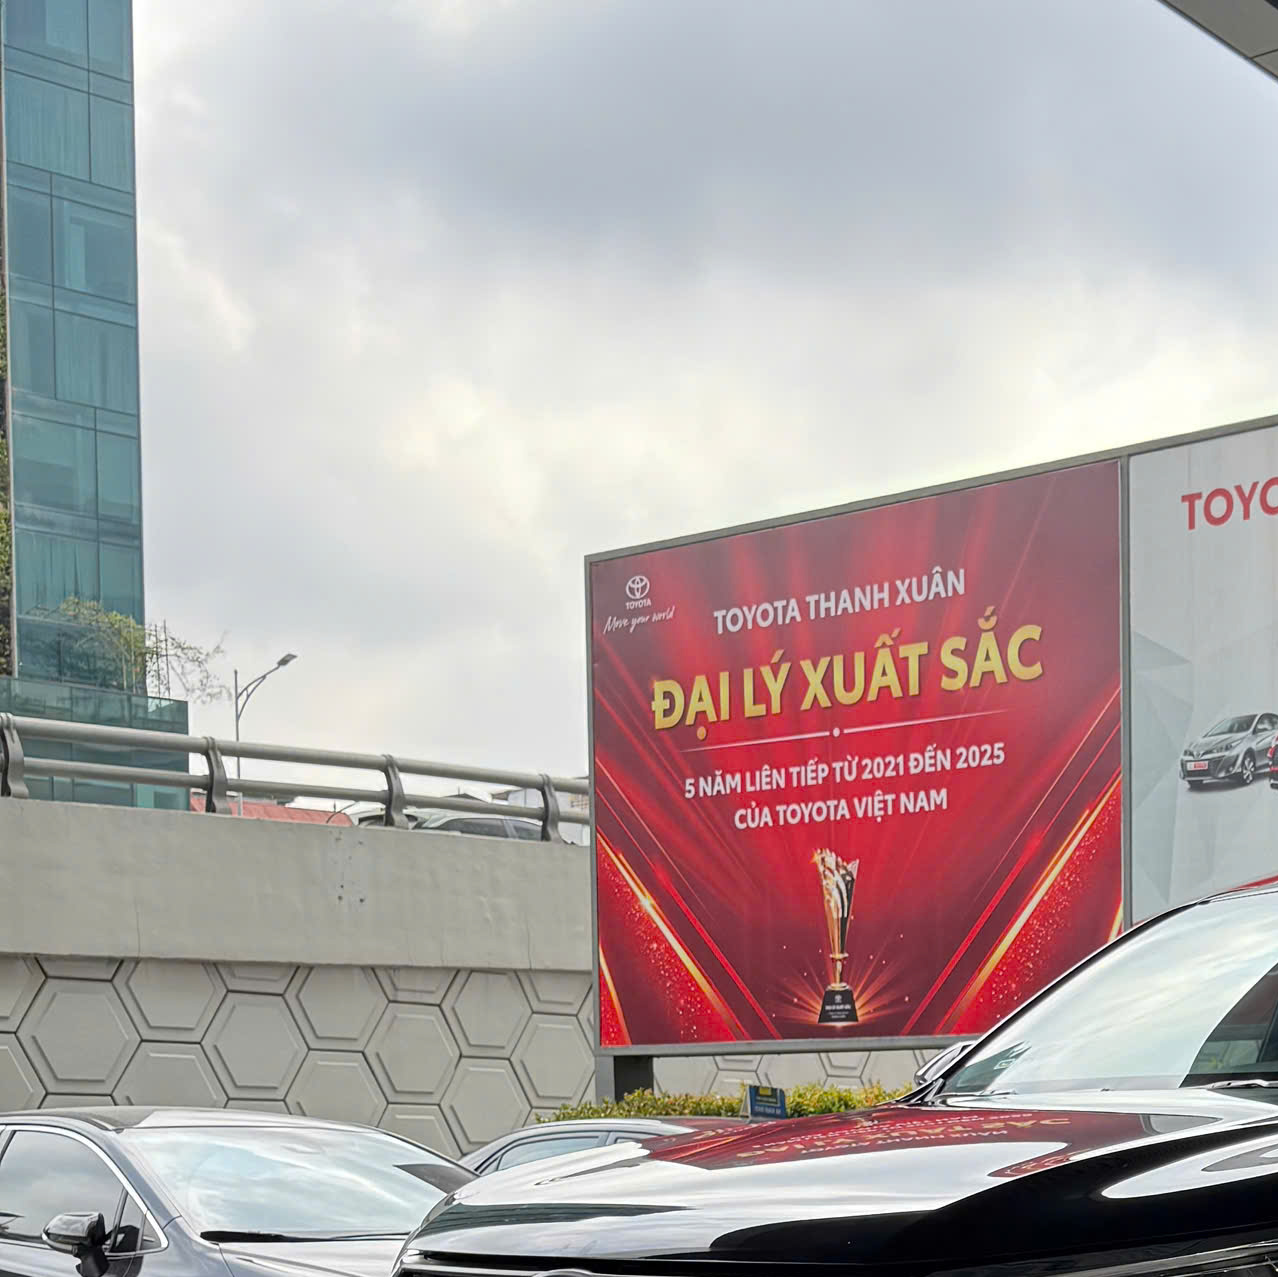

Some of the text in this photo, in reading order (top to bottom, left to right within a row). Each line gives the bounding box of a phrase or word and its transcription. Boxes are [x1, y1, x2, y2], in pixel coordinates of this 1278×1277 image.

[625, 598, 652, 610] TOYOTA
[713, 565, 965, 635] TOYOTA THANH XUÂN
[603, 615, 629, 635] Move
[629, 615, 650, 633] your
[651, 605, 1043, 741] ĐẠI LÝ XUẤT SẮC
[684, 742, 1005, 799] 5 NĂM LIÊN TIẾP TỪ 2021 ĐẾN 2025
[734, 788, 948, 829] CỦA TOYOTA VIỆT NAM
